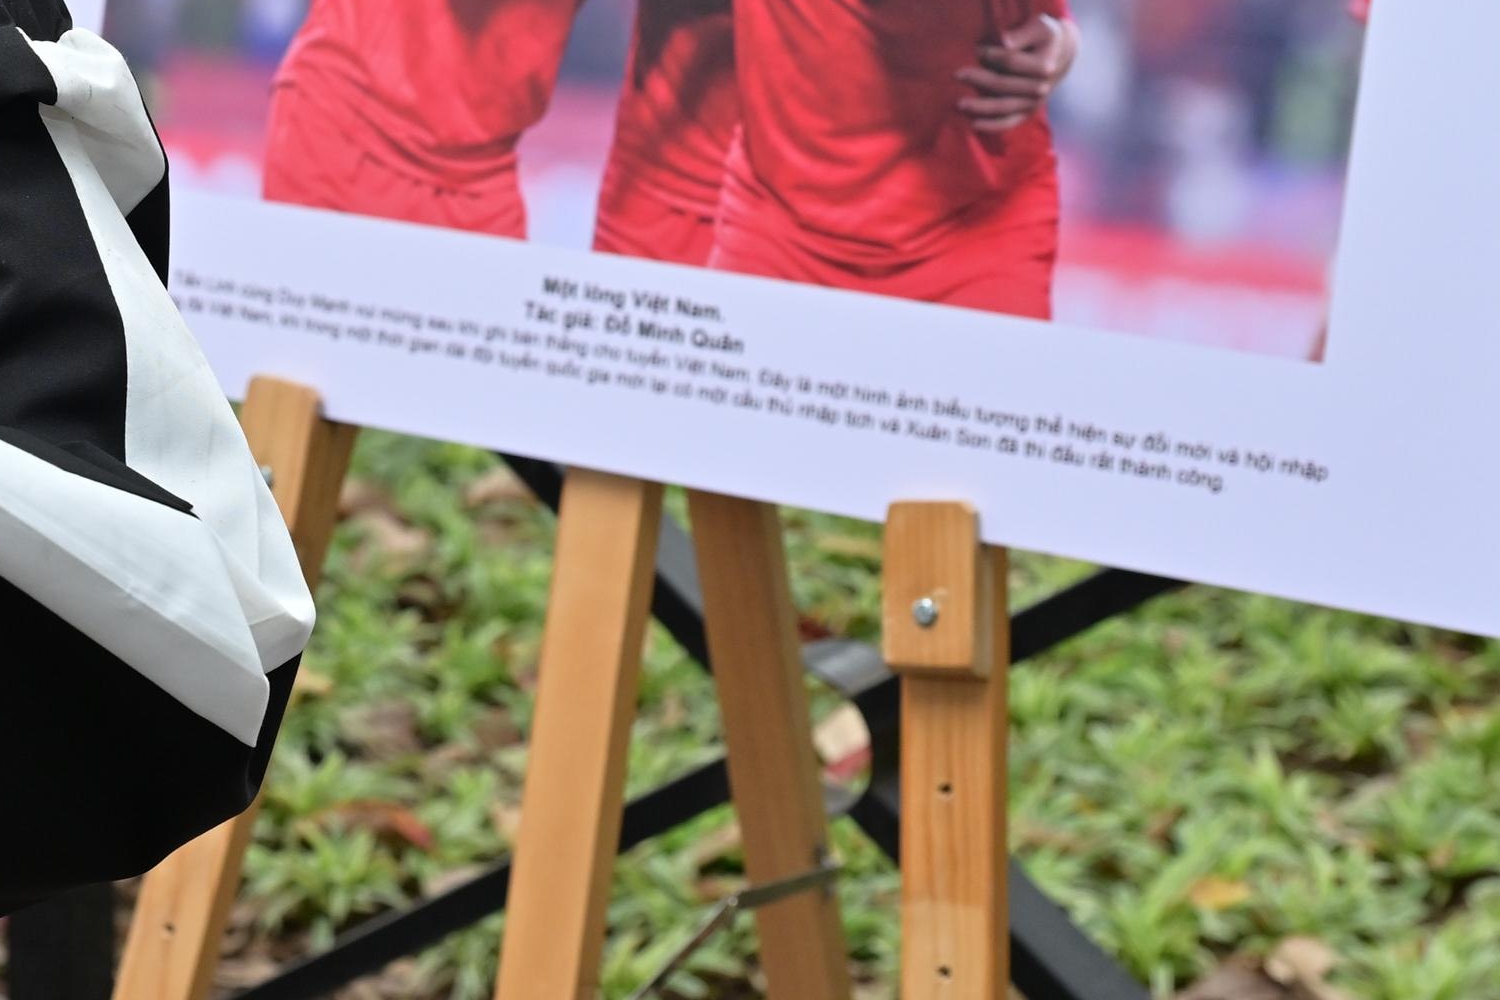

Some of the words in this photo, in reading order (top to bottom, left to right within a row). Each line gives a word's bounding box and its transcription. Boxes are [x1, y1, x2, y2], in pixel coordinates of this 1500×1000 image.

[543, 277, 578, 300] Một
[583, 281, 626, 310] lòng
[632, 289, 669, 314] Việt
[524, 300, 557, 322] Tác
[603, 312, 631, 337] Đỗ
[638, 320, 685, 344] Minh
[690, 327, 745, 355] Quân
[1218, 447, 1240, 466] và
